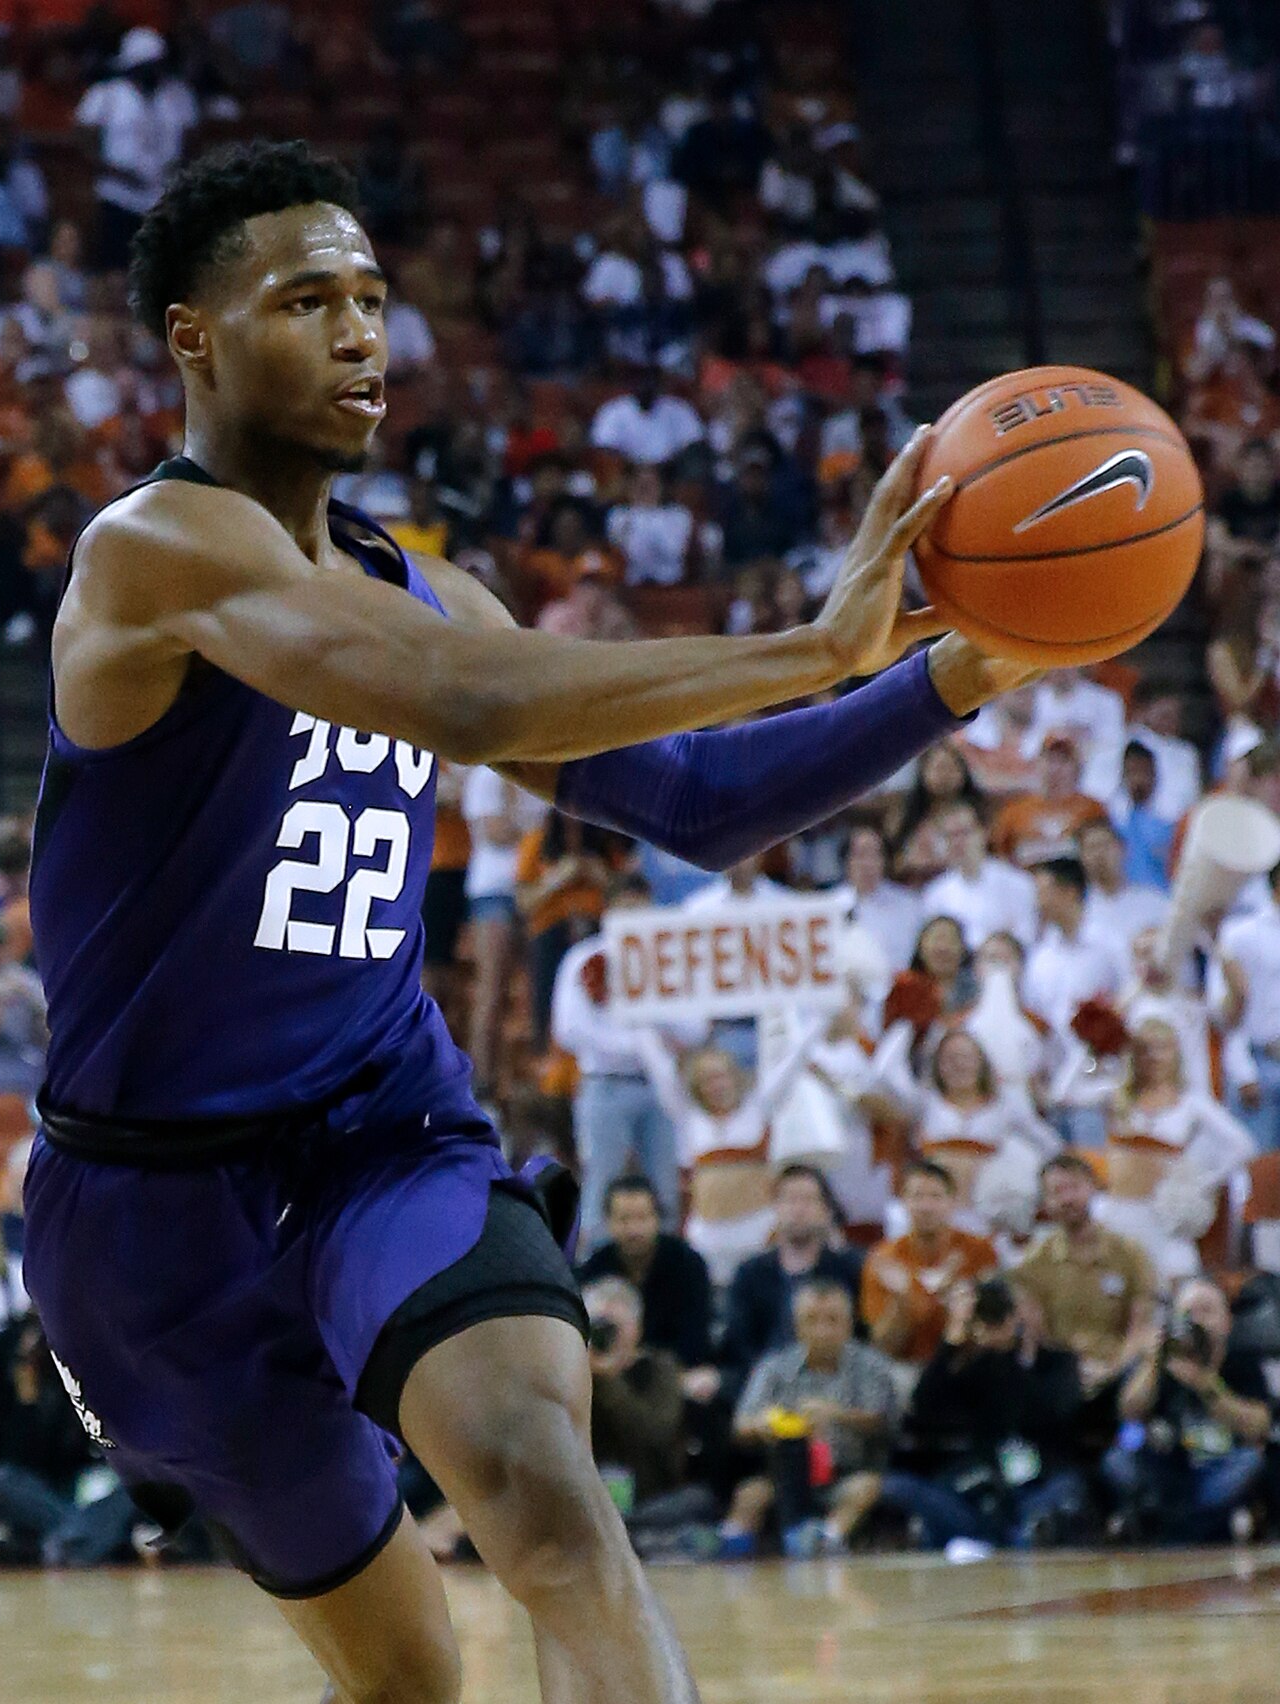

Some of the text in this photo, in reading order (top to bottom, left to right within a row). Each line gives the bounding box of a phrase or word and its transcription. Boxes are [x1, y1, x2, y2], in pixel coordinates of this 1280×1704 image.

[989, 386, 1123, 438] ELITE
[253, 801, 407, 960] 22
[620, 917, 834, 999] DEFENSE
